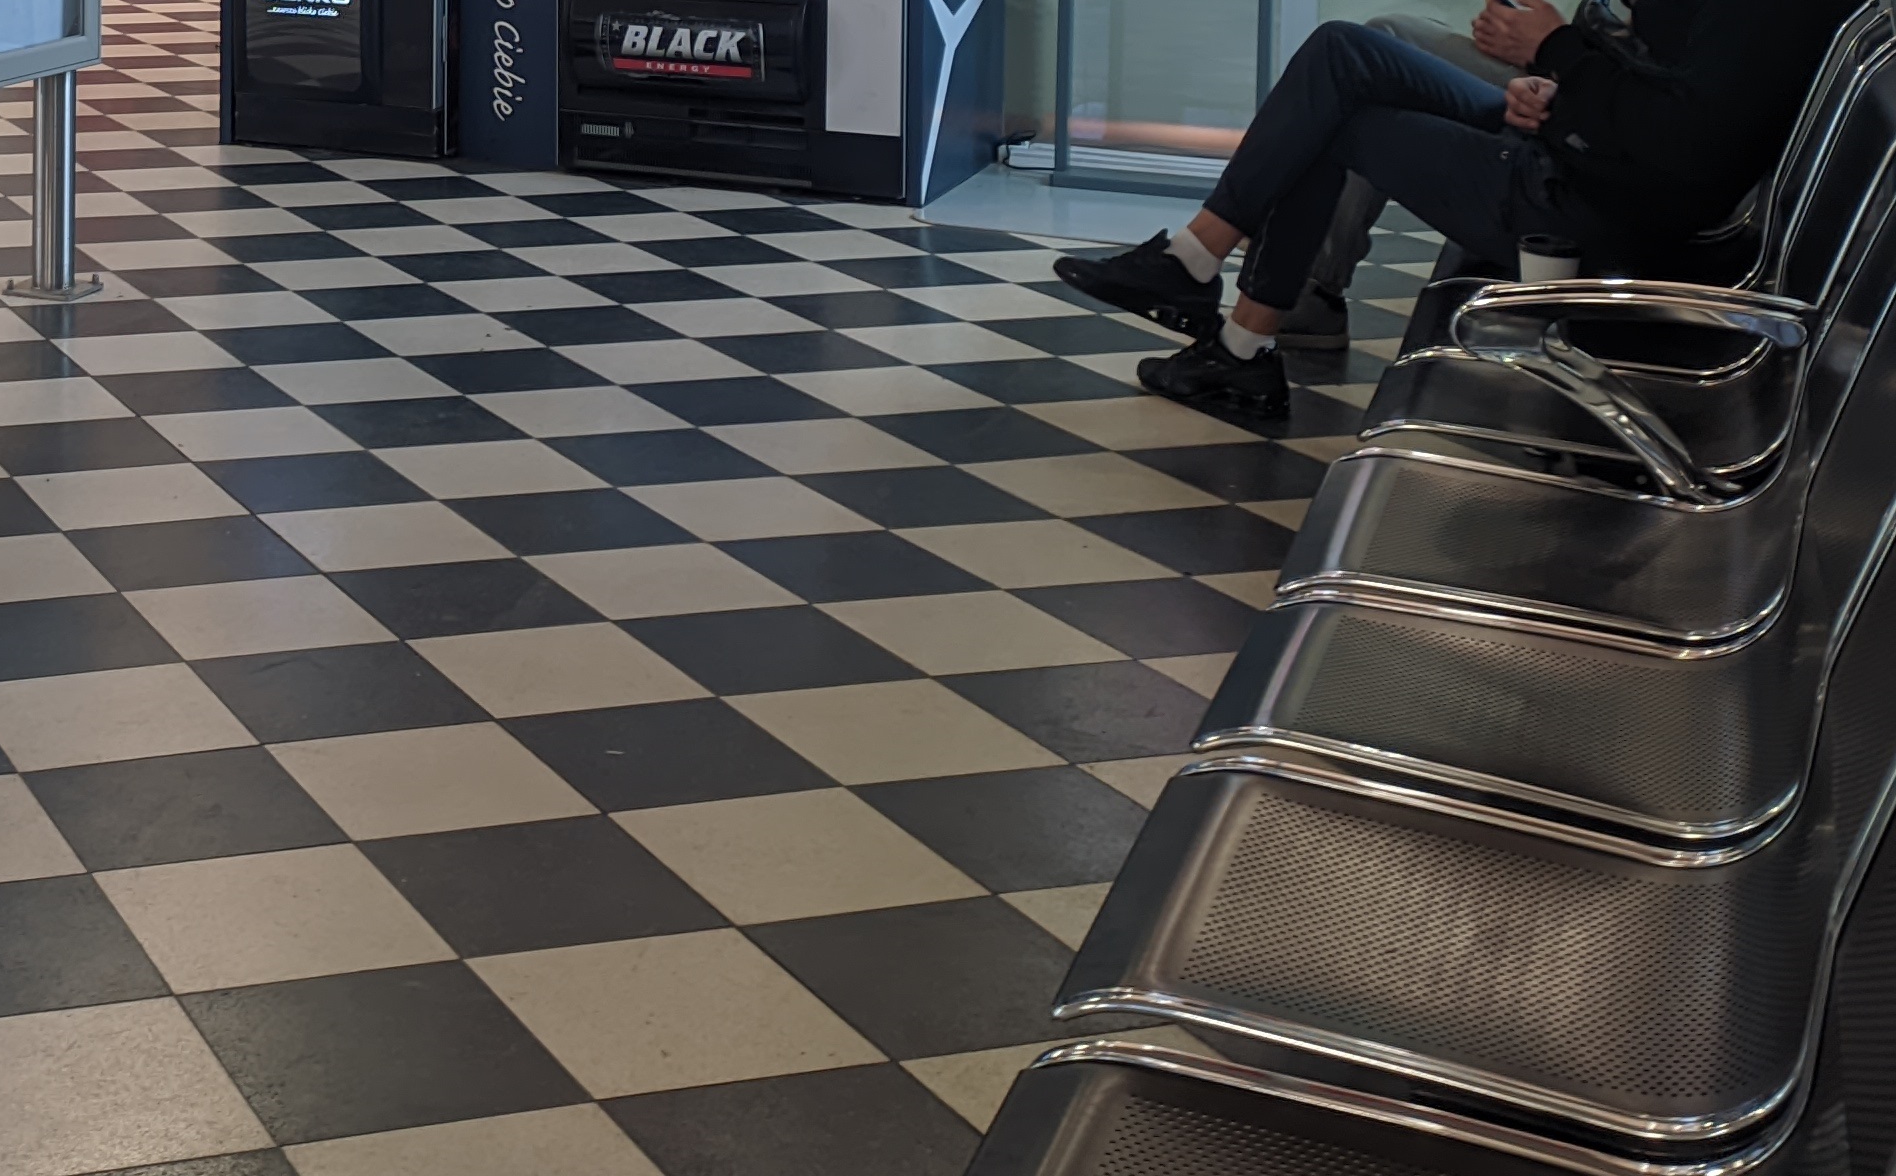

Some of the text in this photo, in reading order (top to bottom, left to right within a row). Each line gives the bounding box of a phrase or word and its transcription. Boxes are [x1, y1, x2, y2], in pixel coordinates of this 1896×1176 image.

[620, 24, 747, 63] BLACK
[493, 21, 526, 122] Ciebie
[645, 61, 711, 74] ENERGY
